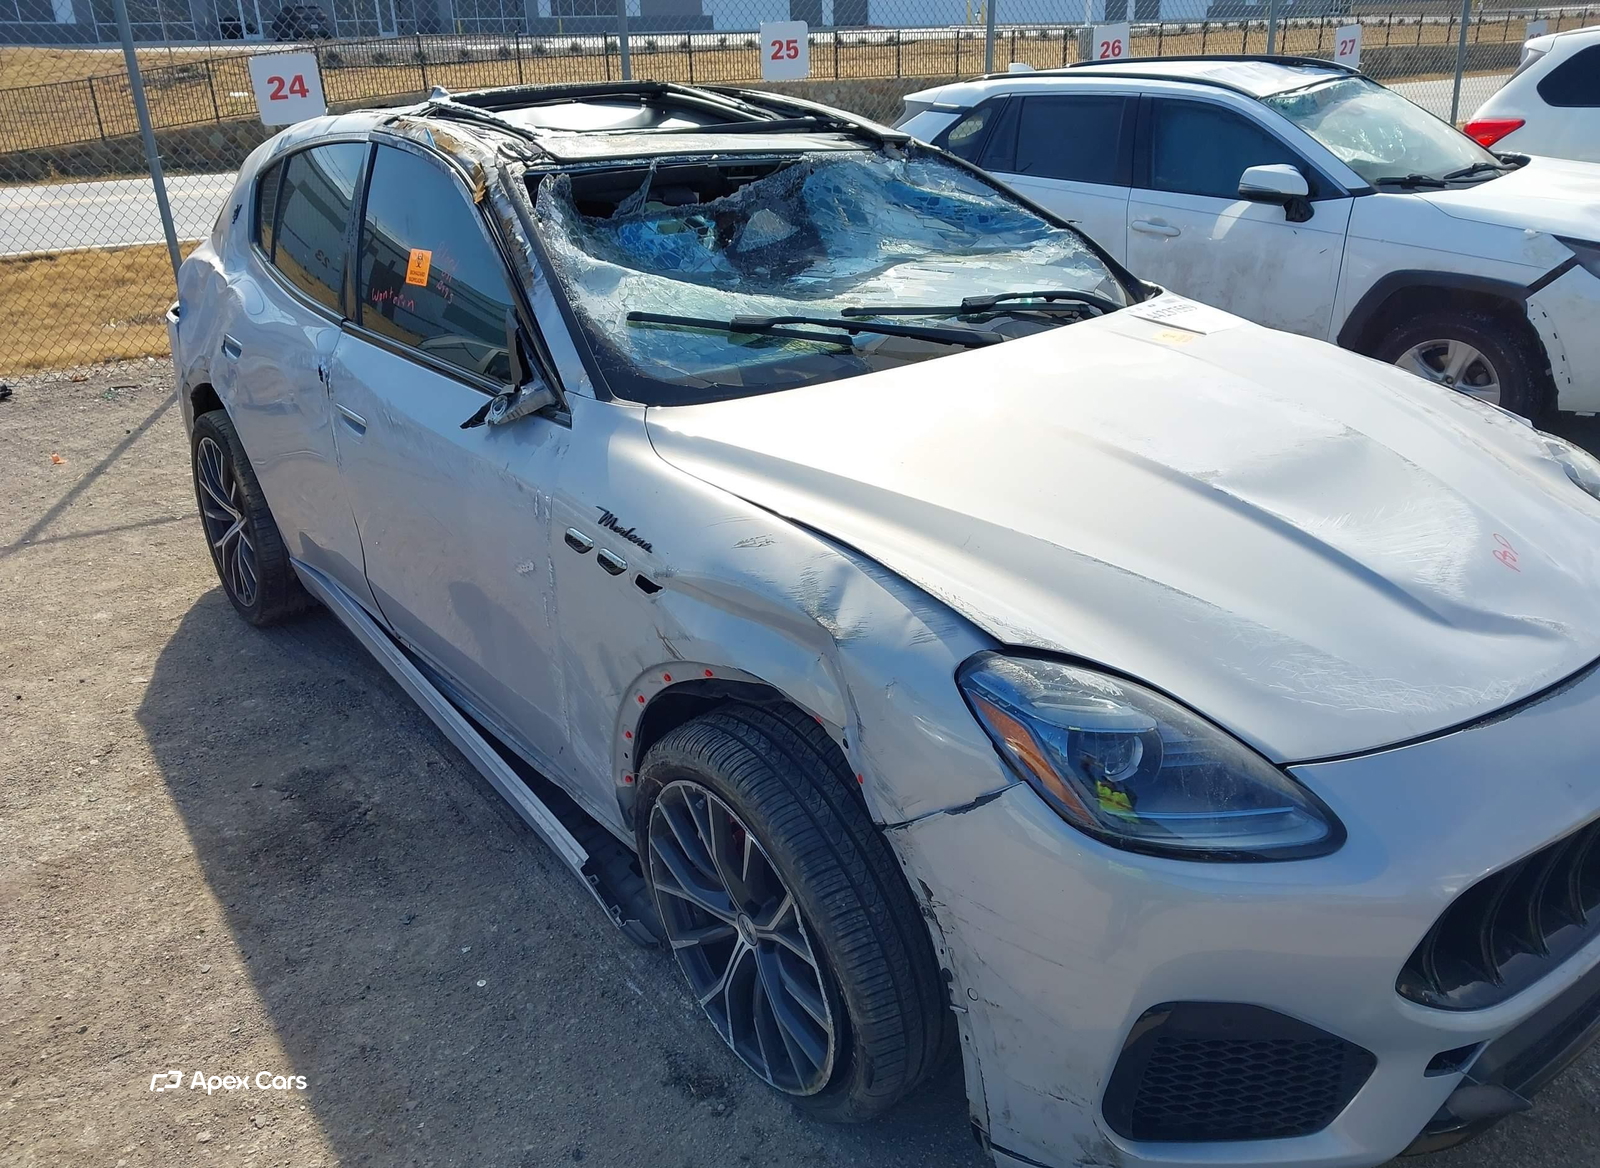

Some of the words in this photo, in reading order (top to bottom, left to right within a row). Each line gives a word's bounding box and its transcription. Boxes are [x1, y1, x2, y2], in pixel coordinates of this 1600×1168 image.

[771, 39, 799, 61] 25
[1100, 39, 1122, 59] 26
[1339, 38, 1356, 56] 27
[267, 74, 310, 101] 24
[595, 505, 653, 554] Modena
